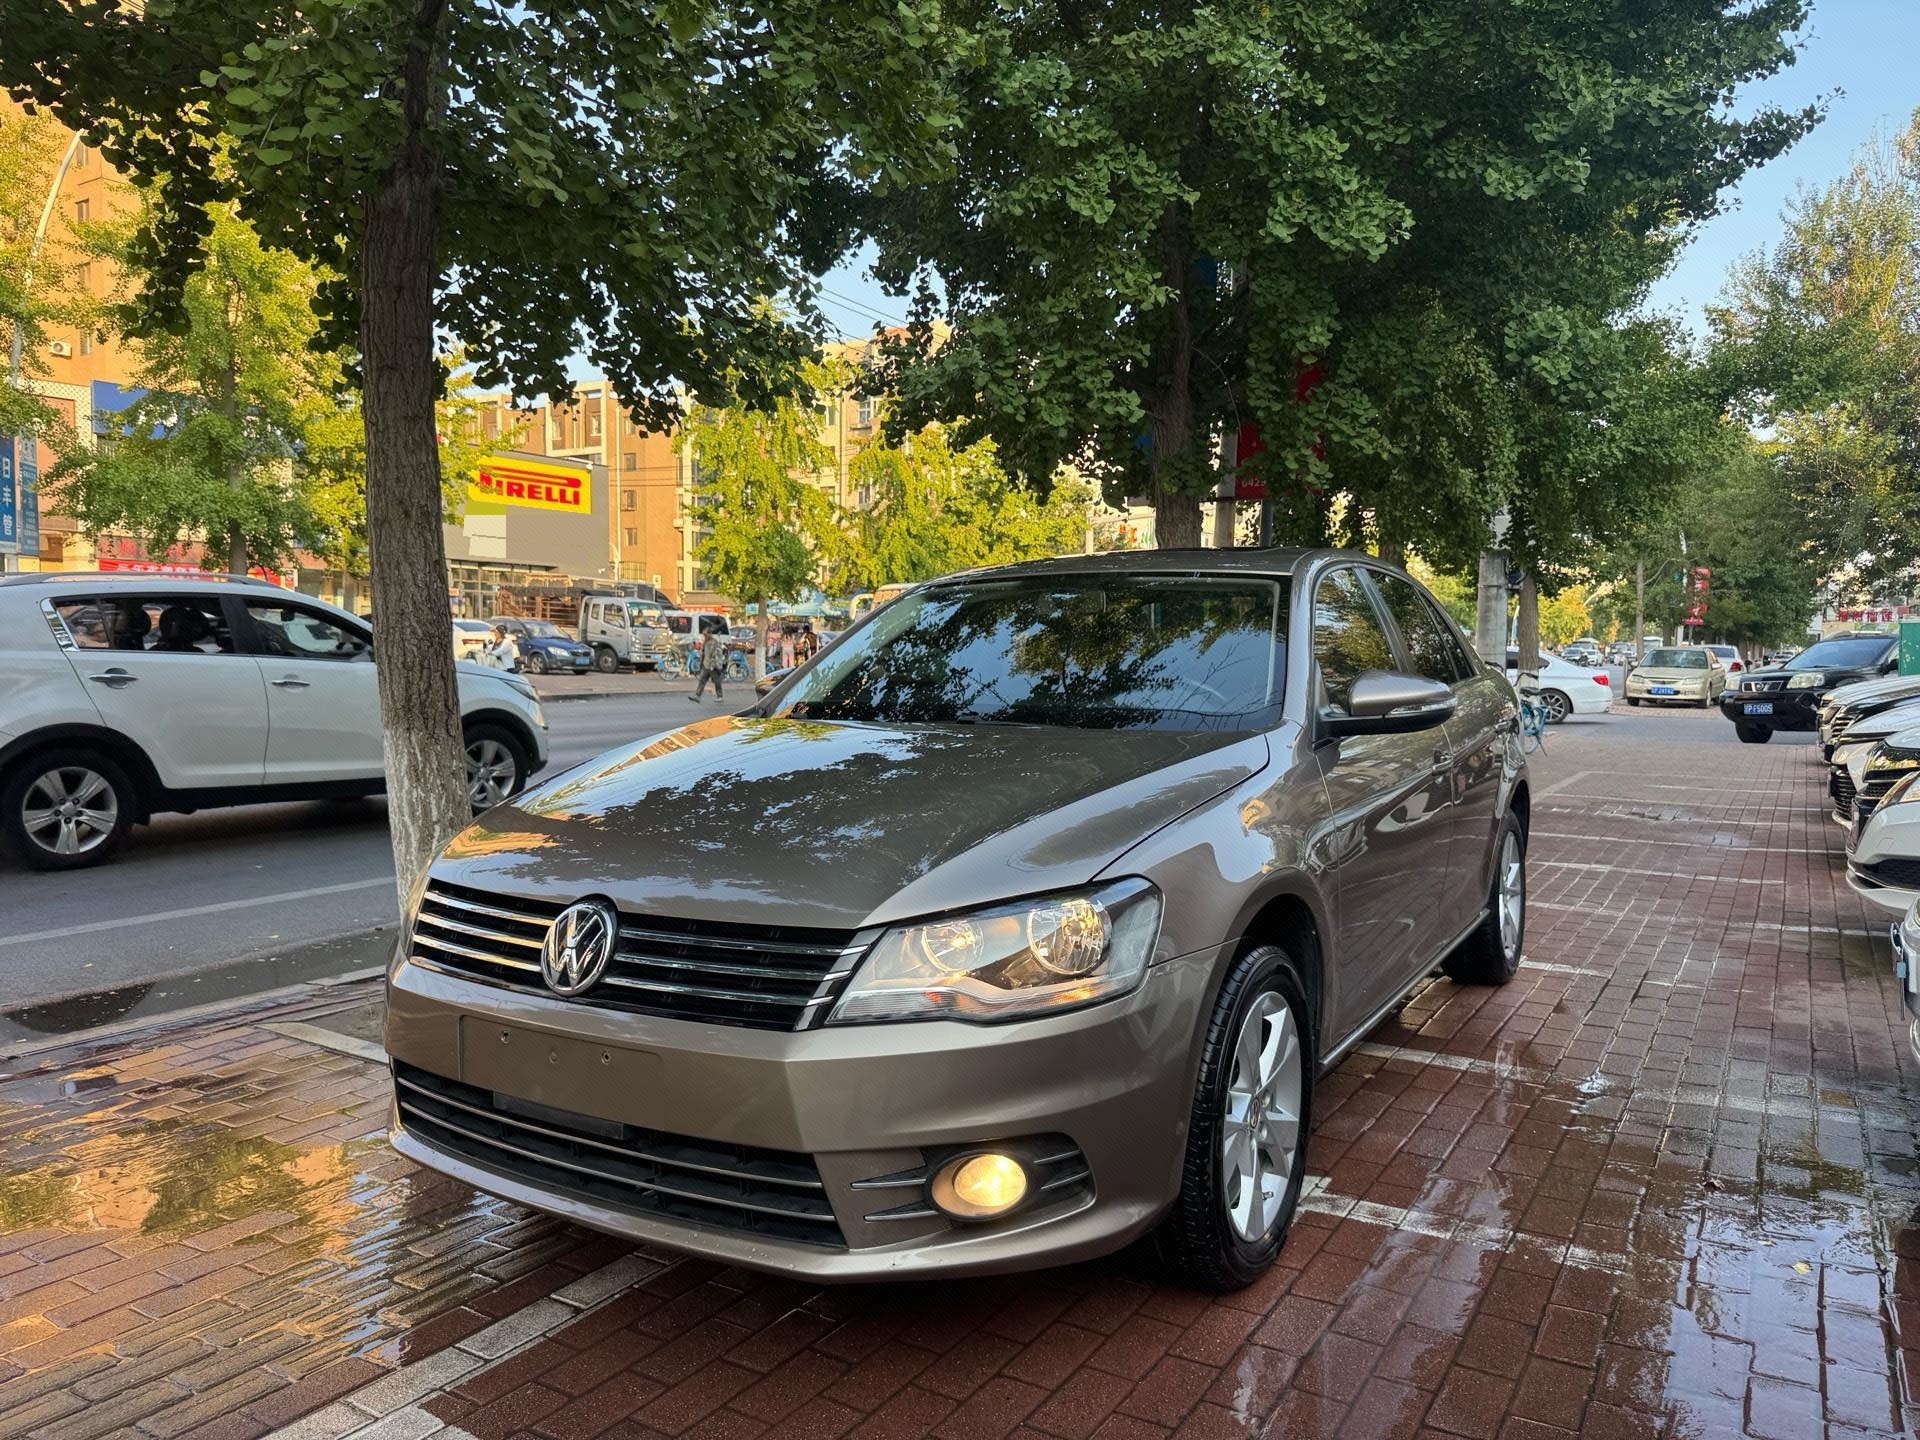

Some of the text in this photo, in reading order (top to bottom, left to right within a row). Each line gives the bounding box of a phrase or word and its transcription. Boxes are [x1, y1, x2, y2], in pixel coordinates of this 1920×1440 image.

[2, 456, 12, 536] 日丰管
[479, 466, 581, 505] PIRELLI
